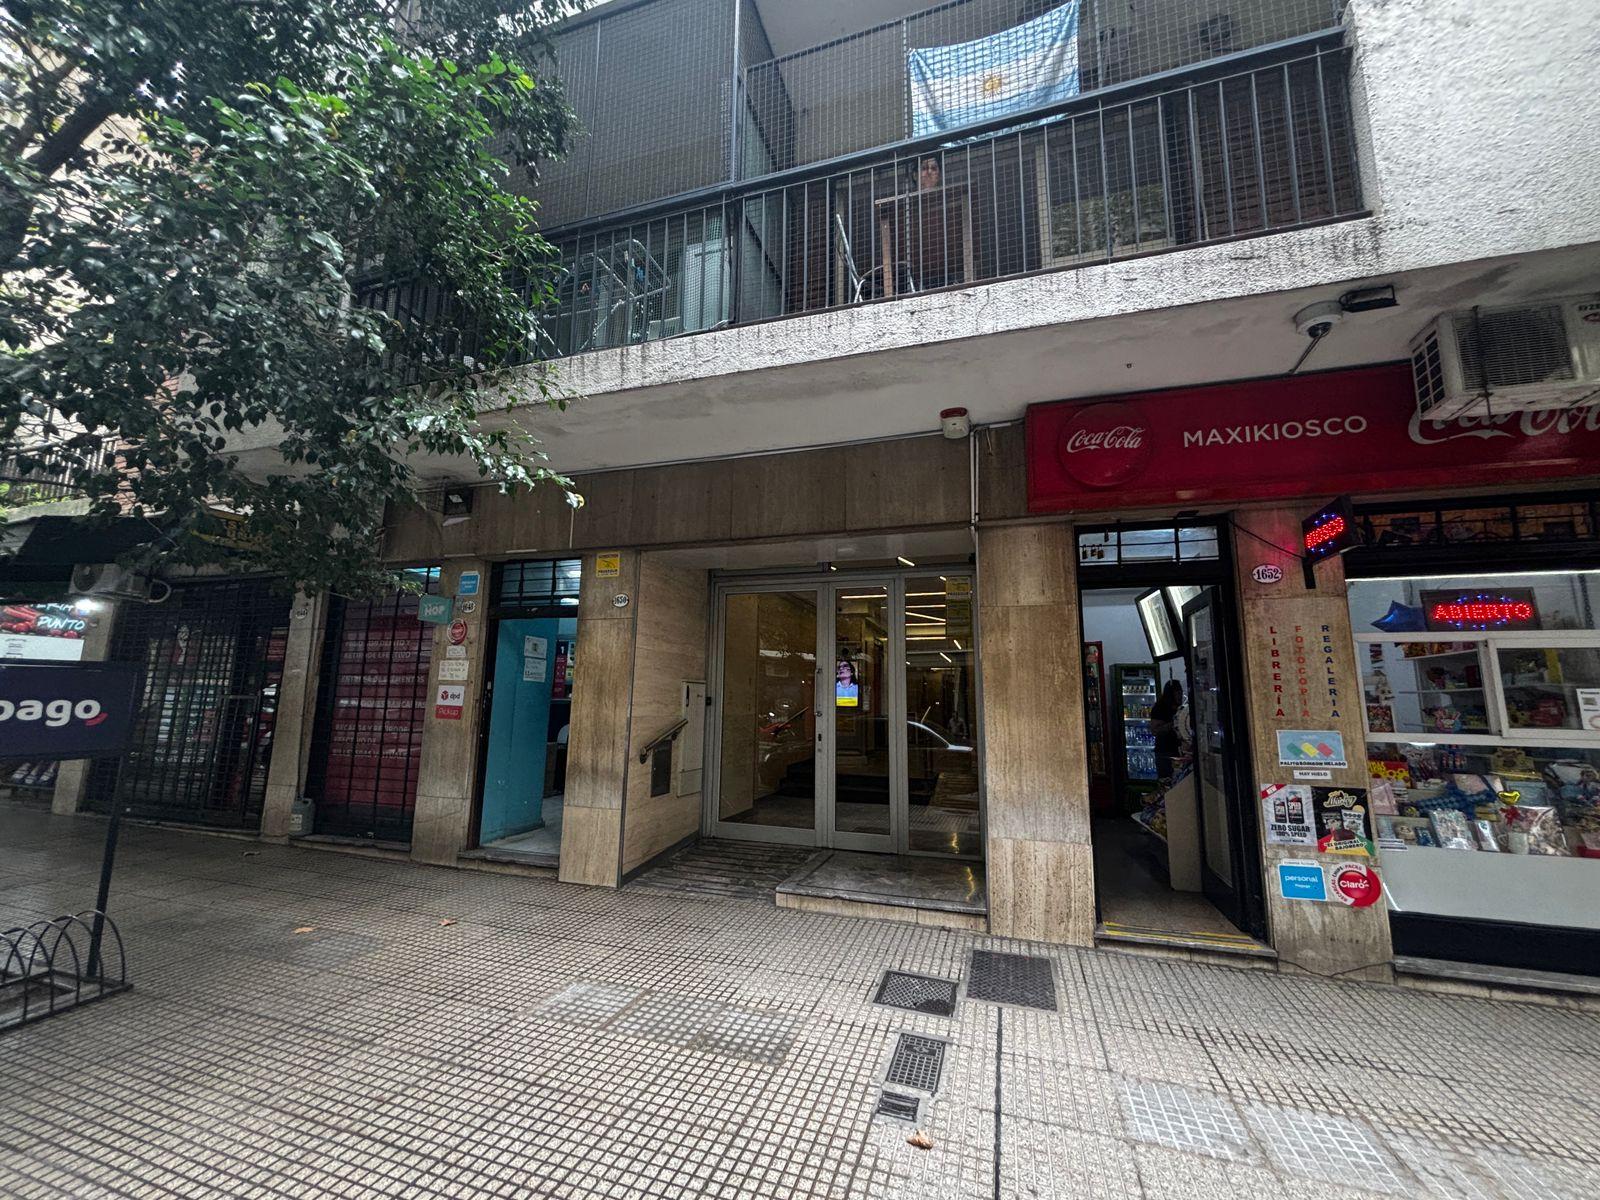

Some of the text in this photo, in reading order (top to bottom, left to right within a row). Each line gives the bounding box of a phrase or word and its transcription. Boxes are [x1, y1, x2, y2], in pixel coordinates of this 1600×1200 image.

[1183, 415, 1368, 448] MAXIKIOSCO
[1306, 517, 1344, 549] KIOSCO
[1255, 568, 1279, 580] 1652
[1433, 603, 1531, 619] ABIERTO
[37, 616, 85, 630] PUNTO
[1294, 625, 1310, 717] FOTOCOPIA
[1321, 625, 1341, 717] REGALERIA
[450, 692, 460, 701] dpd
[1271, 824, 1311, 833] ZERO SUGAR
[1284, 875, 1319, 883] personal
[1339, 879, 1366, 889] Claro
